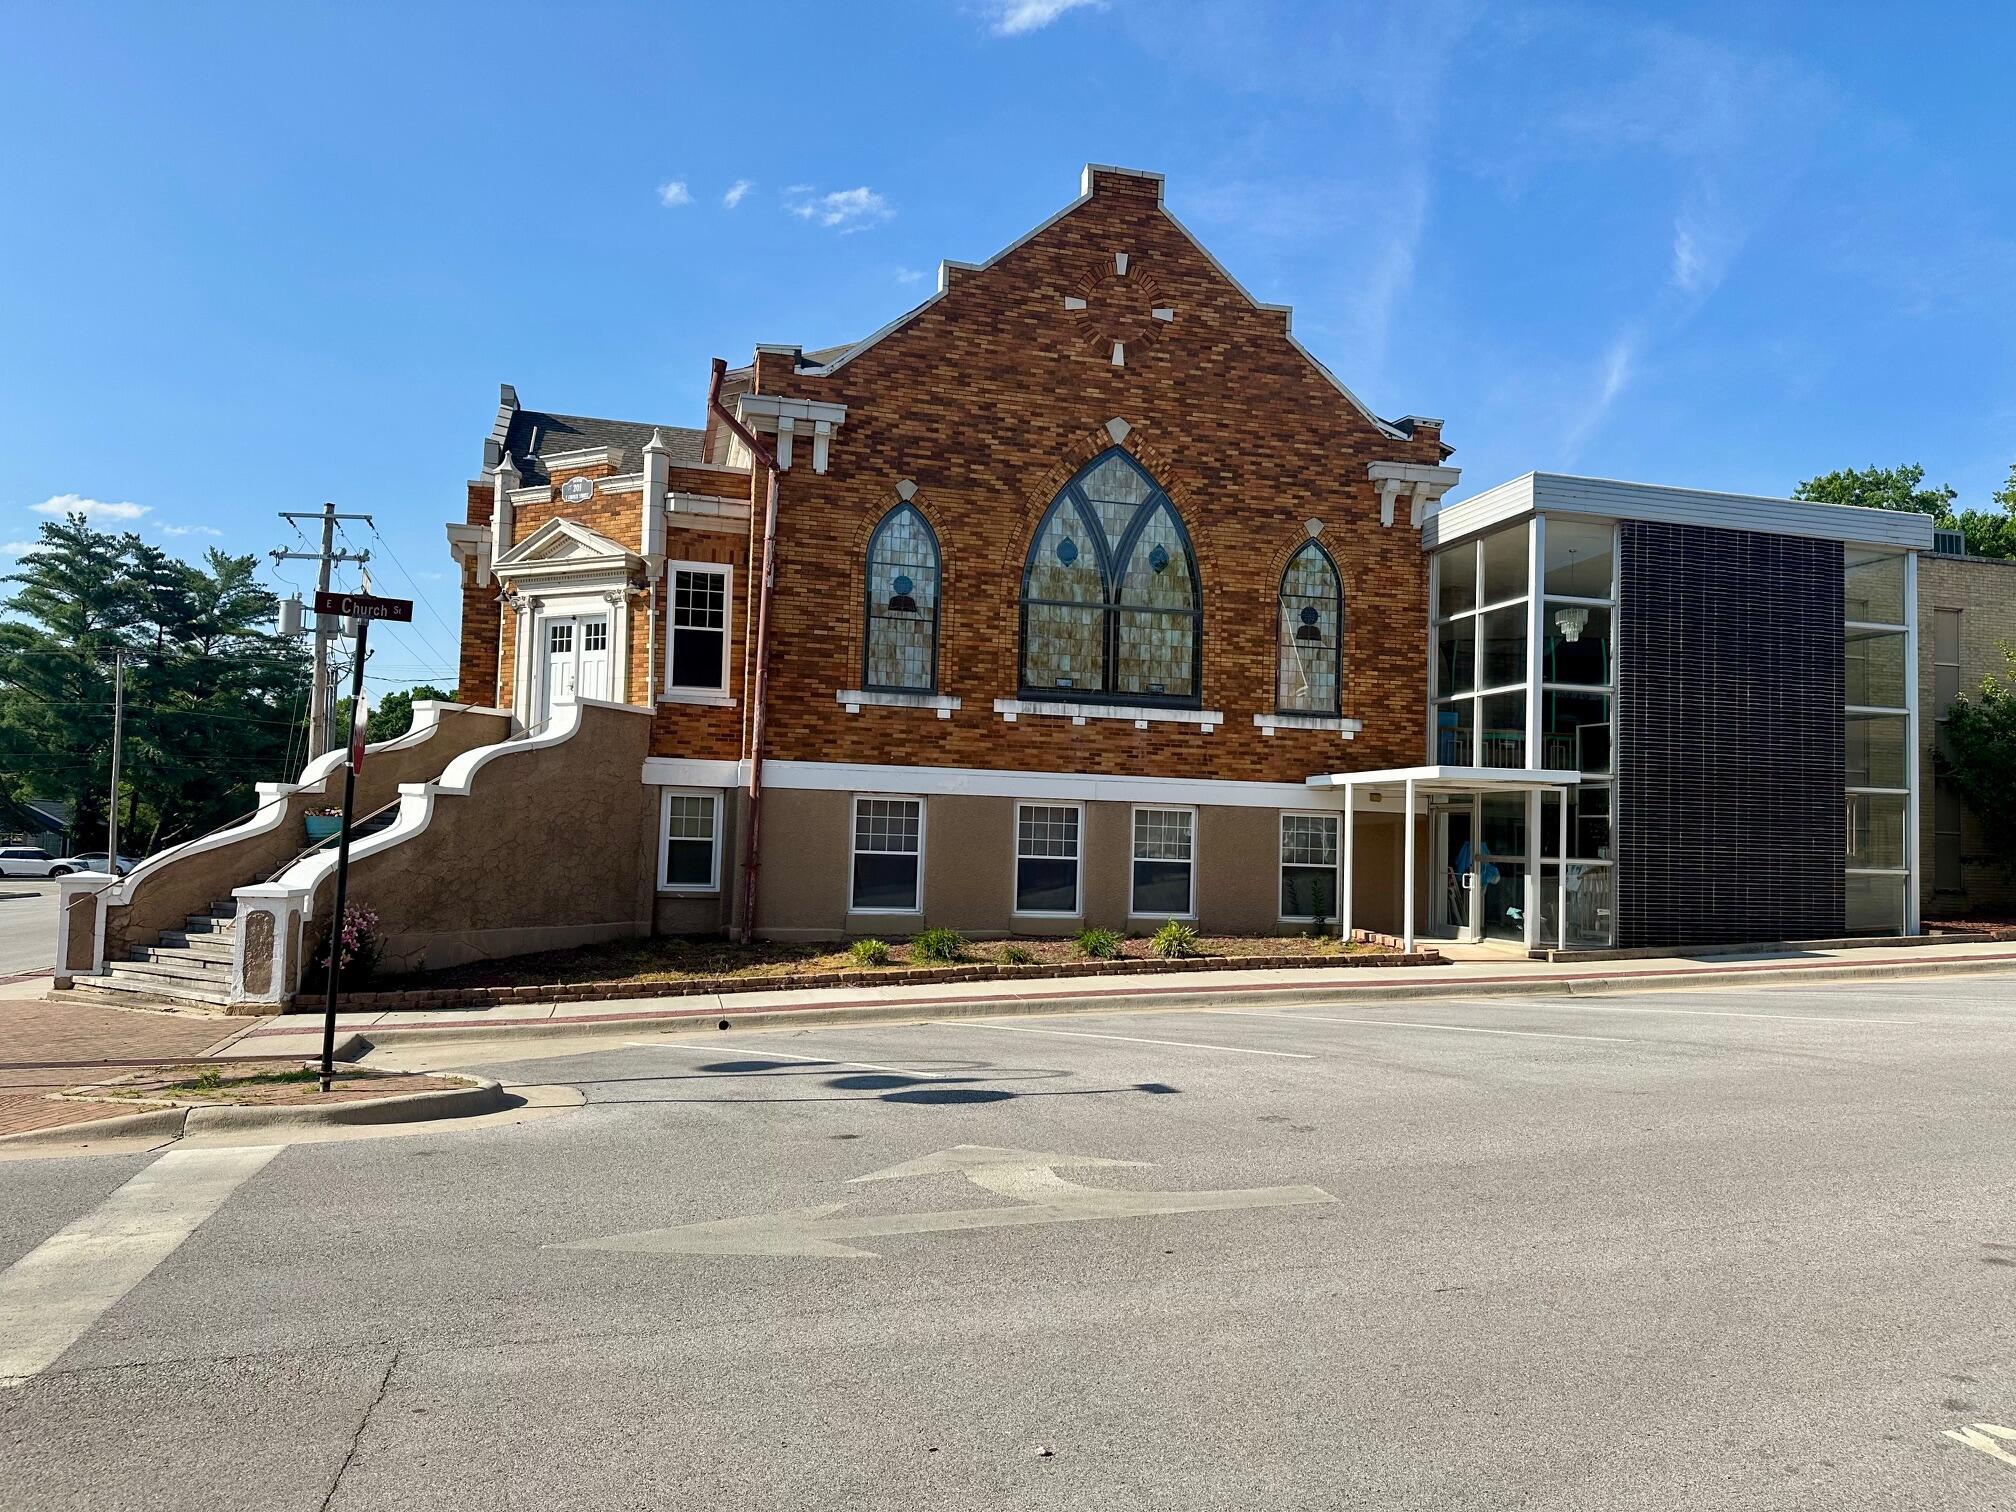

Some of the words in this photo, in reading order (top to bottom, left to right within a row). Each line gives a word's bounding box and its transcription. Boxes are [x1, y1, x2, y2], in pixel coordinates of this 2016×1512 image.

[573, 483, 582, 493] 201
[326, 599, 332, 608] E
[341, 597, 388, 617] Church
[393, 605, 402, 615] St
